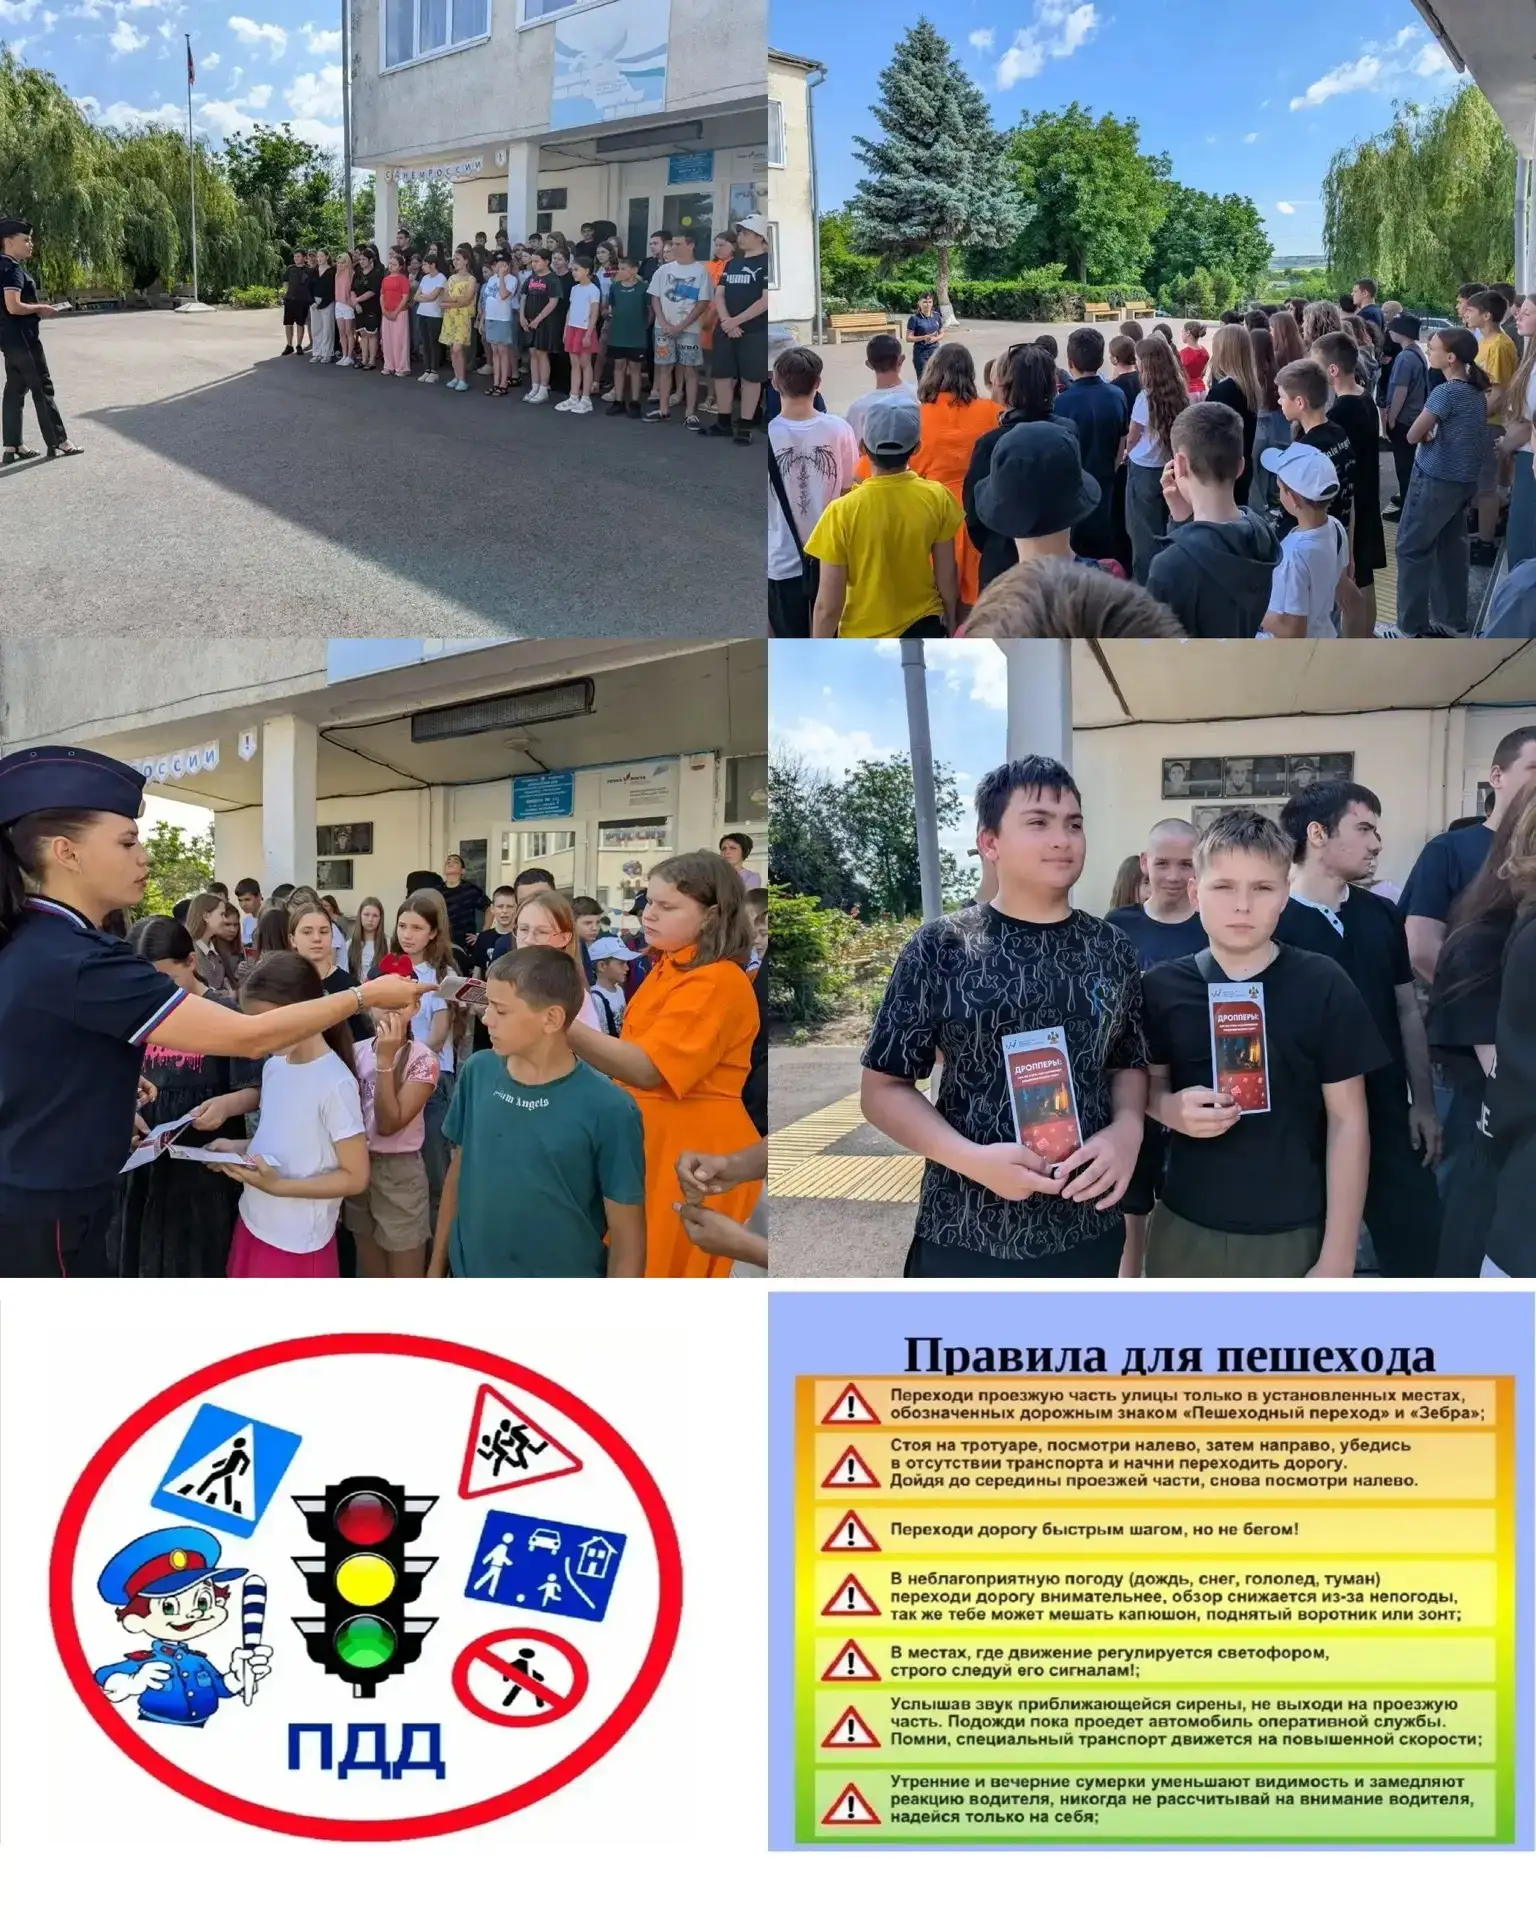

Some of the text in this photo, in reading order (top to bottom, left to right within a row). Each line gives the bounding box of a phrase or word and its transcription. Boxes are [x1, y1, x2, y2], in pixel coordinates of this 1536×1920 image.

[132, 750, 215, 778] ОССИИ
[1218, 1013, 1260, 1024] ДРОППЕРЫ:
[1014, 1059, 1063, 1075] ДРОППЕРЫ:
[515, 1096, 550, 1111] Angels
[904, 1337, 1436, 1376] Правила для пешехода
[891, 1387, 1465, 1405] Переходи проезжую часть улицы только в установленных местах,
[890, 1405, 1485, 1422] обозначенных дорожным знаком «Пешеходный переход» и «Зебра»;
[890, 1437, 1412, 1455] Стоя на тротуаре, посмотри налево, затем направо, убедись
[891, 1458, 1347, 1473] в отсутствии транспорта и начни переходить дорогу.
[889, 1473, 1418, 1490] Дойдя до середины проезжей части, снова посмотри налево.
[891, 1521, 1299, 1539] Переходи дорогу быстрым шагом, но не бегом!
[891, 1571, 1381, 1588] В неблагоприятную погоду (дождь, снег, гололед, туман)
[891, 1589, 1458, 1606] переходи дорогу внимательнее, обзор снижается из-за непогоды,
[890, 1607, 1461, 1624] так же тебе может мешать капюшон, поднятый воротник или зонт;
[891, 1645, 1329, 1662] В местах, где движение регулируется светофором,
[890, 1663, 1140, 1680] строго следуй его сигналам!;
[890, 1696, 1458, 1714] Услышав звук приближающейся сирены, не выходи на проезжую
[890, 1712, 1446, 1732] часть. Подожди пока проедет автомобиль оперативной службы.
[890, 1731, 1483, 1749] Помни, специальный транспорт движется на повышенной скорости;
[288, 1722, 446, 1780] ПДД
[890, 1774, 1465, 1792] Утренние и вечерние сумерки уменьшают видимость и замедляют
[890, 1791, 1475, 1809] реакцию водителя, никогда не рассчитывай на внимание водителя,
[890, 1809, 1100, 1825] надейся только на себя;
